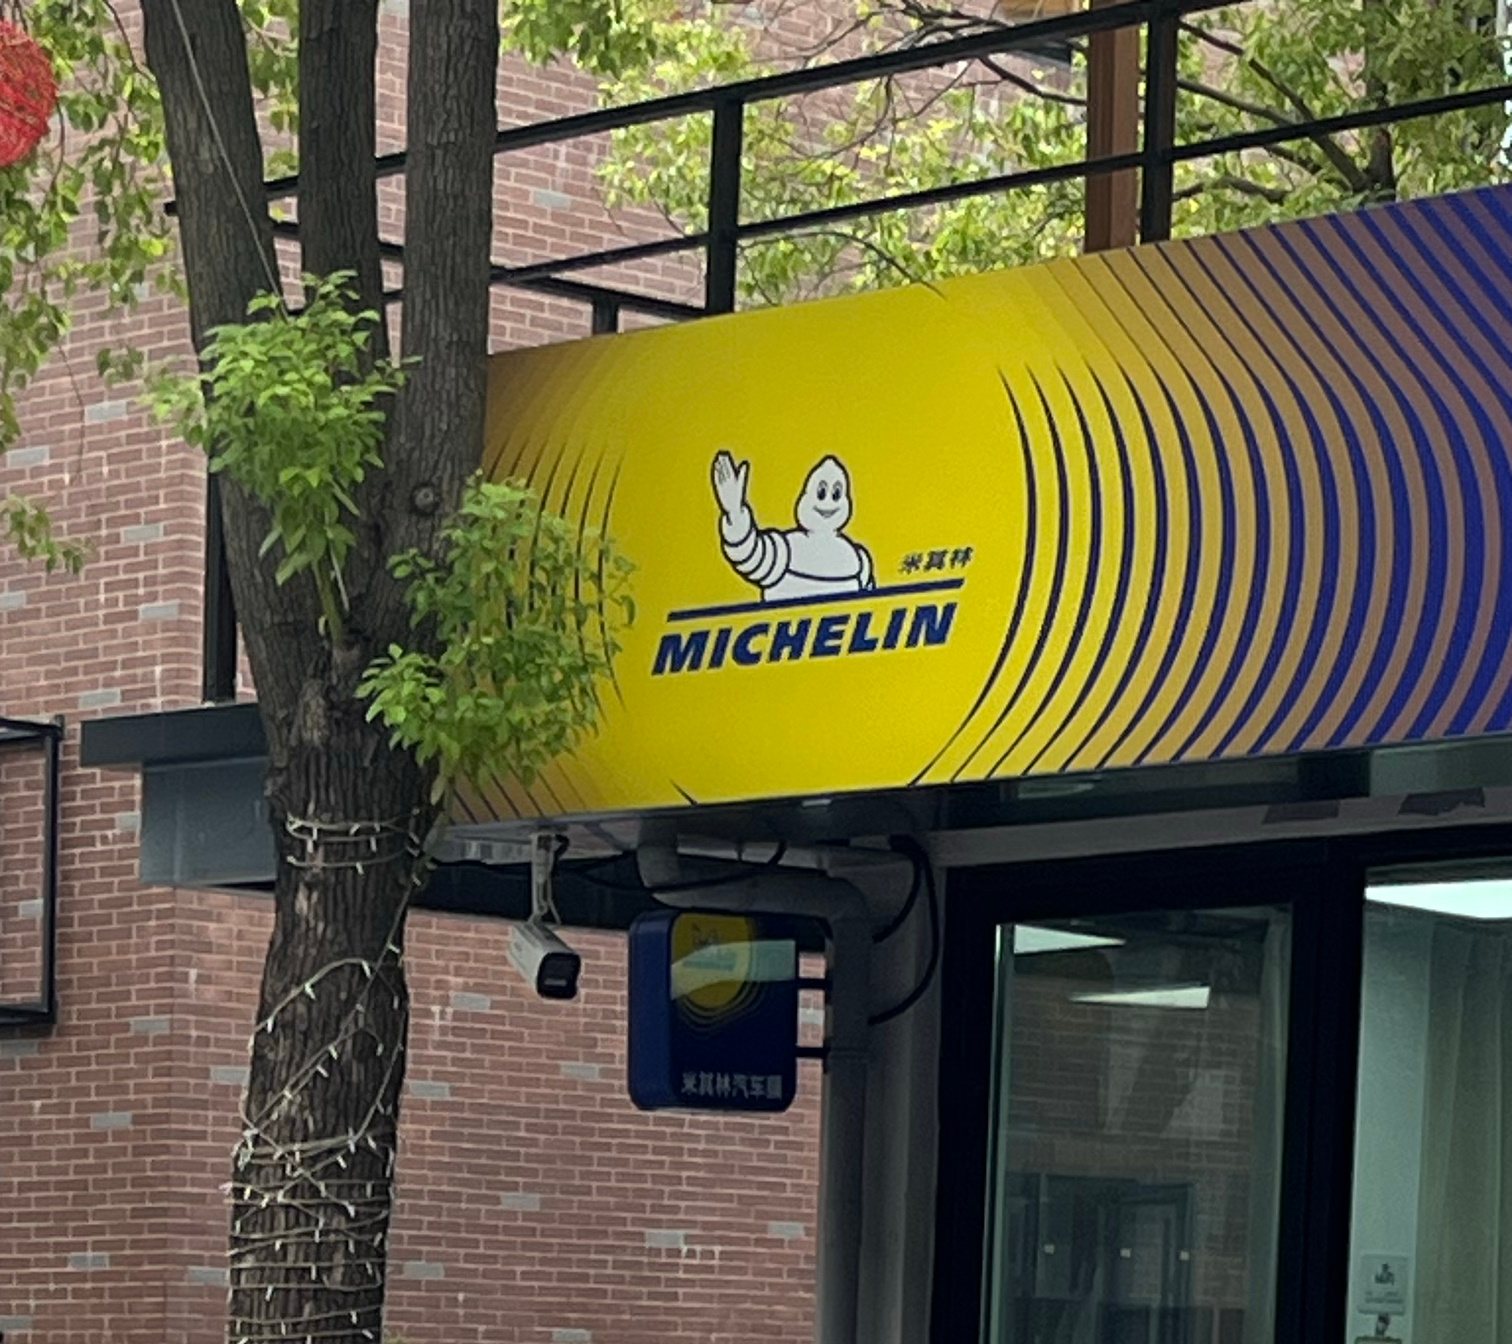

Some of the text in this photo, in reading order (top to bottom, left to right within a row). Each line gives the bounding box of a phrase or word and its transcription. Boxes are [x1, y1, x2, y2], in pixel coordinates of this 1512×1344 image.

[899, 546, 974, 574] 米其林
[651, 601, 957, 677] MICHELIN
